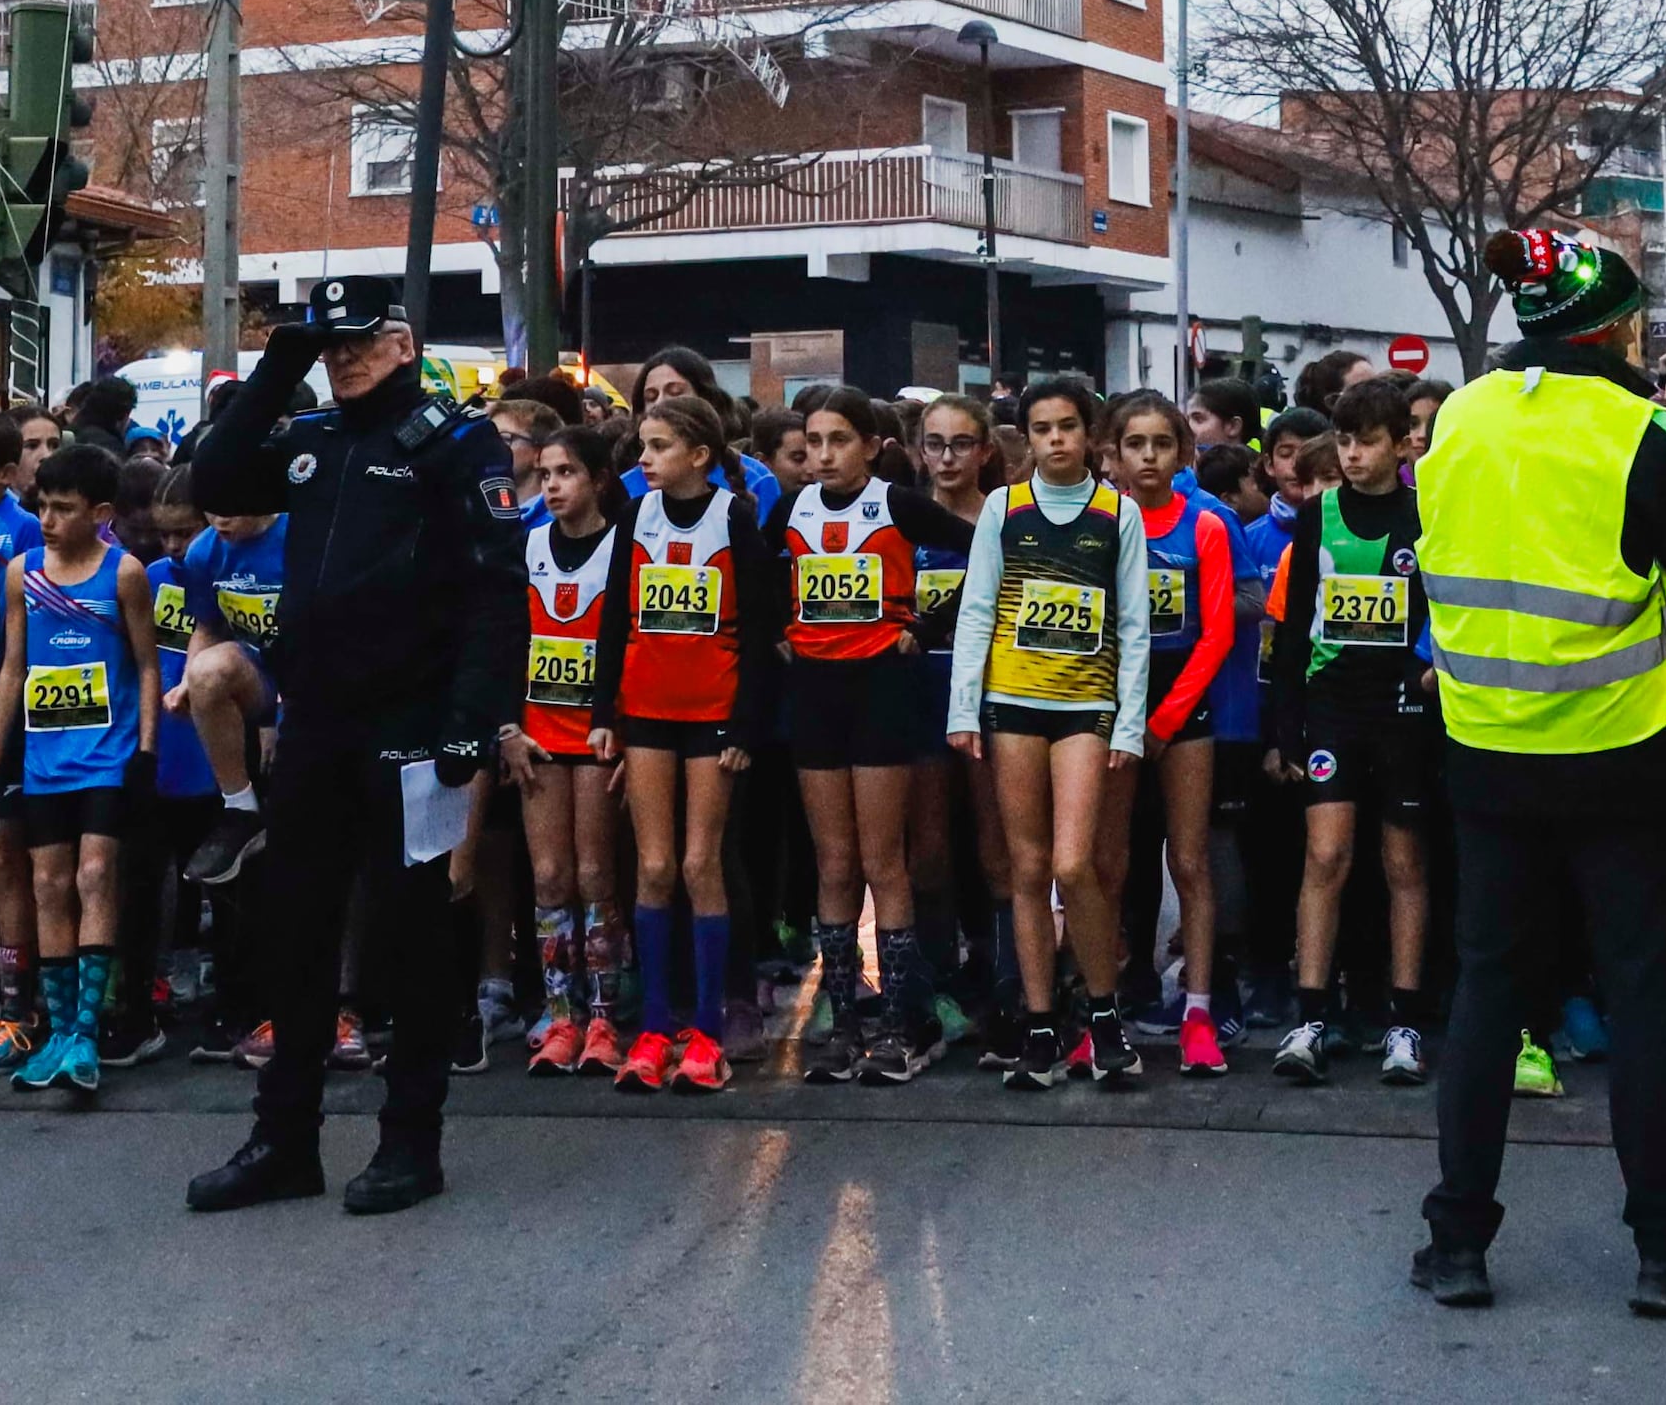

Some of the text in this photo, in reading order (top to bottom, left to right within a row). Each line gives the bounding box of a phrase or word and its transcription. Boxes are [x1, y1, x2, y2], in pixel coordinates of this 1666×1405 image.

[366, 466, 414, 478] POLICÍA
[646, 584, 708, 611] 2043
[806, 574, 869, 599] 2052
[1025, 601, 1092, 631] 2225
[1332, 595, 1395, 622] 2370
[535, 656, 592, 684] 2051
[34, 683, 97, 710] 2291
